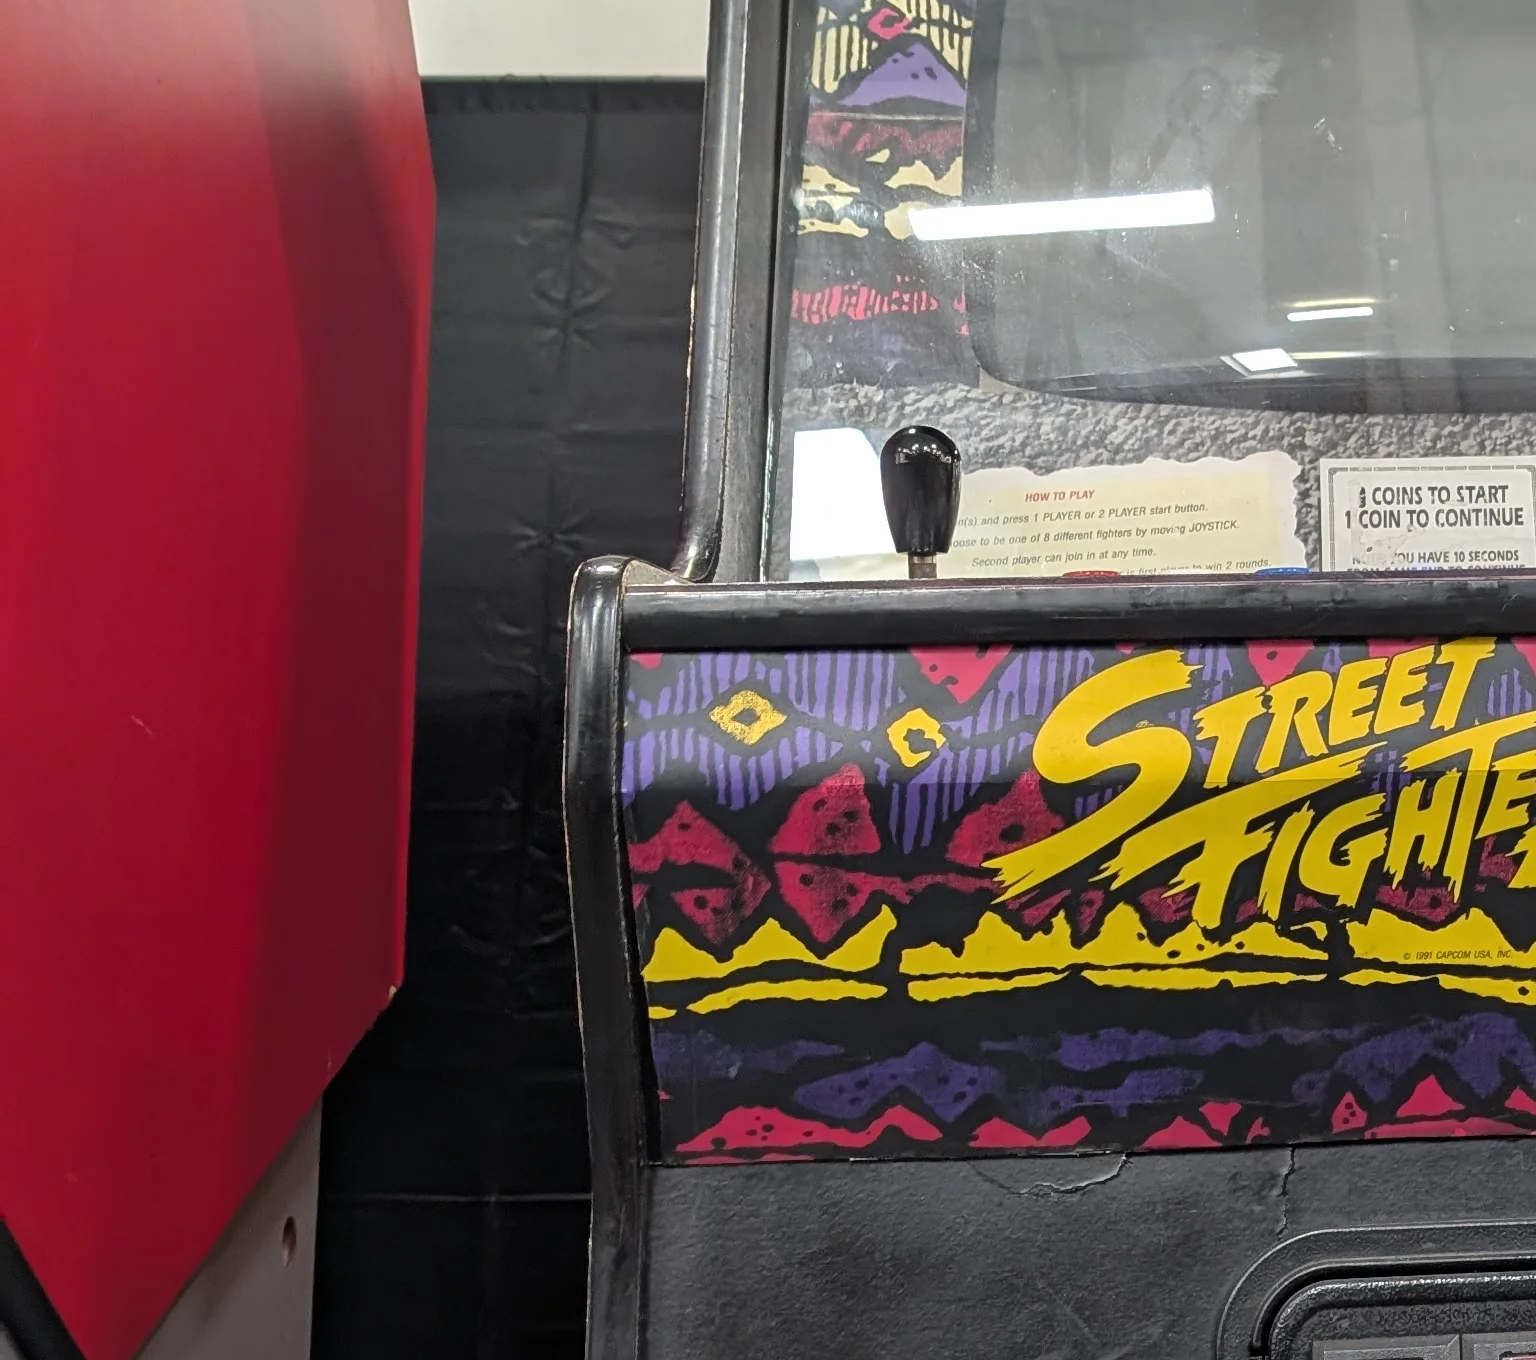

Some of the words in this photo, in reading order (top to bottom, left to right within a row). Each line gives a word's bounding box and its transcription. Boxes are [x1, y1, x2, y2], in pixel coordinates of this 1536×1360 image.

[1024, 492, 1051, 503] HOW
[1053, 491, 1066, 501] TO
[1069, 490, 1095, 500] PLAY
[1372, 486, 1423, 506] COINS
[1428, 485, 1451, 505] TO
[1456, 484, 1509, 504] START
[958, 516, 978, 527] n(s)
[981, 515, 999, 525] and
[1002, 514, 1029, 525] press
[1034, 513, 1039, 523] 1
[1042, 510, 1081, 522] PLAYER
[1084, 511, 1096, 520] or
[1098, 509, 1105, 519] 2
[1108, 506, 1147, 518] PLAYER
[1150, 505, 1171, 515] start
[1175, 503, 1208, 514] button.
[1344, 510, 1351, 529] 1
[1358, 509, 1401, 529] COIN
[1406, 509, 1430, 528] TO
[1435, 507, 1524, 528] CONTINUE
[952, 538, 977, 548] oose
[980, 538, 990, 547] to
[993, 536, 1005, 545] be
[1008, 536, 1027, 545] one
[1030, 533, 1041, 543] of
[1043, 533, 1050, 542] 8
[1053, 530, 1093, 541] different
[1096, 527, 1132, 540] fighters
[1135, 527, 1148, 538] by
[1150, 525, 1186, 536] moving
[1189, 520, 1240, 533] JOYSTICK.
[971, 556, 1009, 567] Second
[1012, 555, 1041, 567] player
[1044, 554, 1062, 563] can
[1064, 553, 1084, 563] join
[1086, 551, 1096, 560] in
[1098, 551, 1108, 560] at
[1111, 549, 1129, 559] any
[1132, 547, 1156, 557] time.
[1205, 562, 1222, 571] win
[1226, 561, 1232, 570] 2
[1235, 558, 1272, 569] rounds.
[1418, 551, 1450, 563] HAVE
[1453, 551, 1466, 562] 10
[1468, 550, 1519, 561] SECONDS
[982, 637, 1497, 905] STREET
[1415, 951, 1433, 960] 1991
[1436, 950, 1471, 960] CAPCOM
[1474, 950, 1493, 959] USA,
[1496, 950, 1513, 959] INC.
